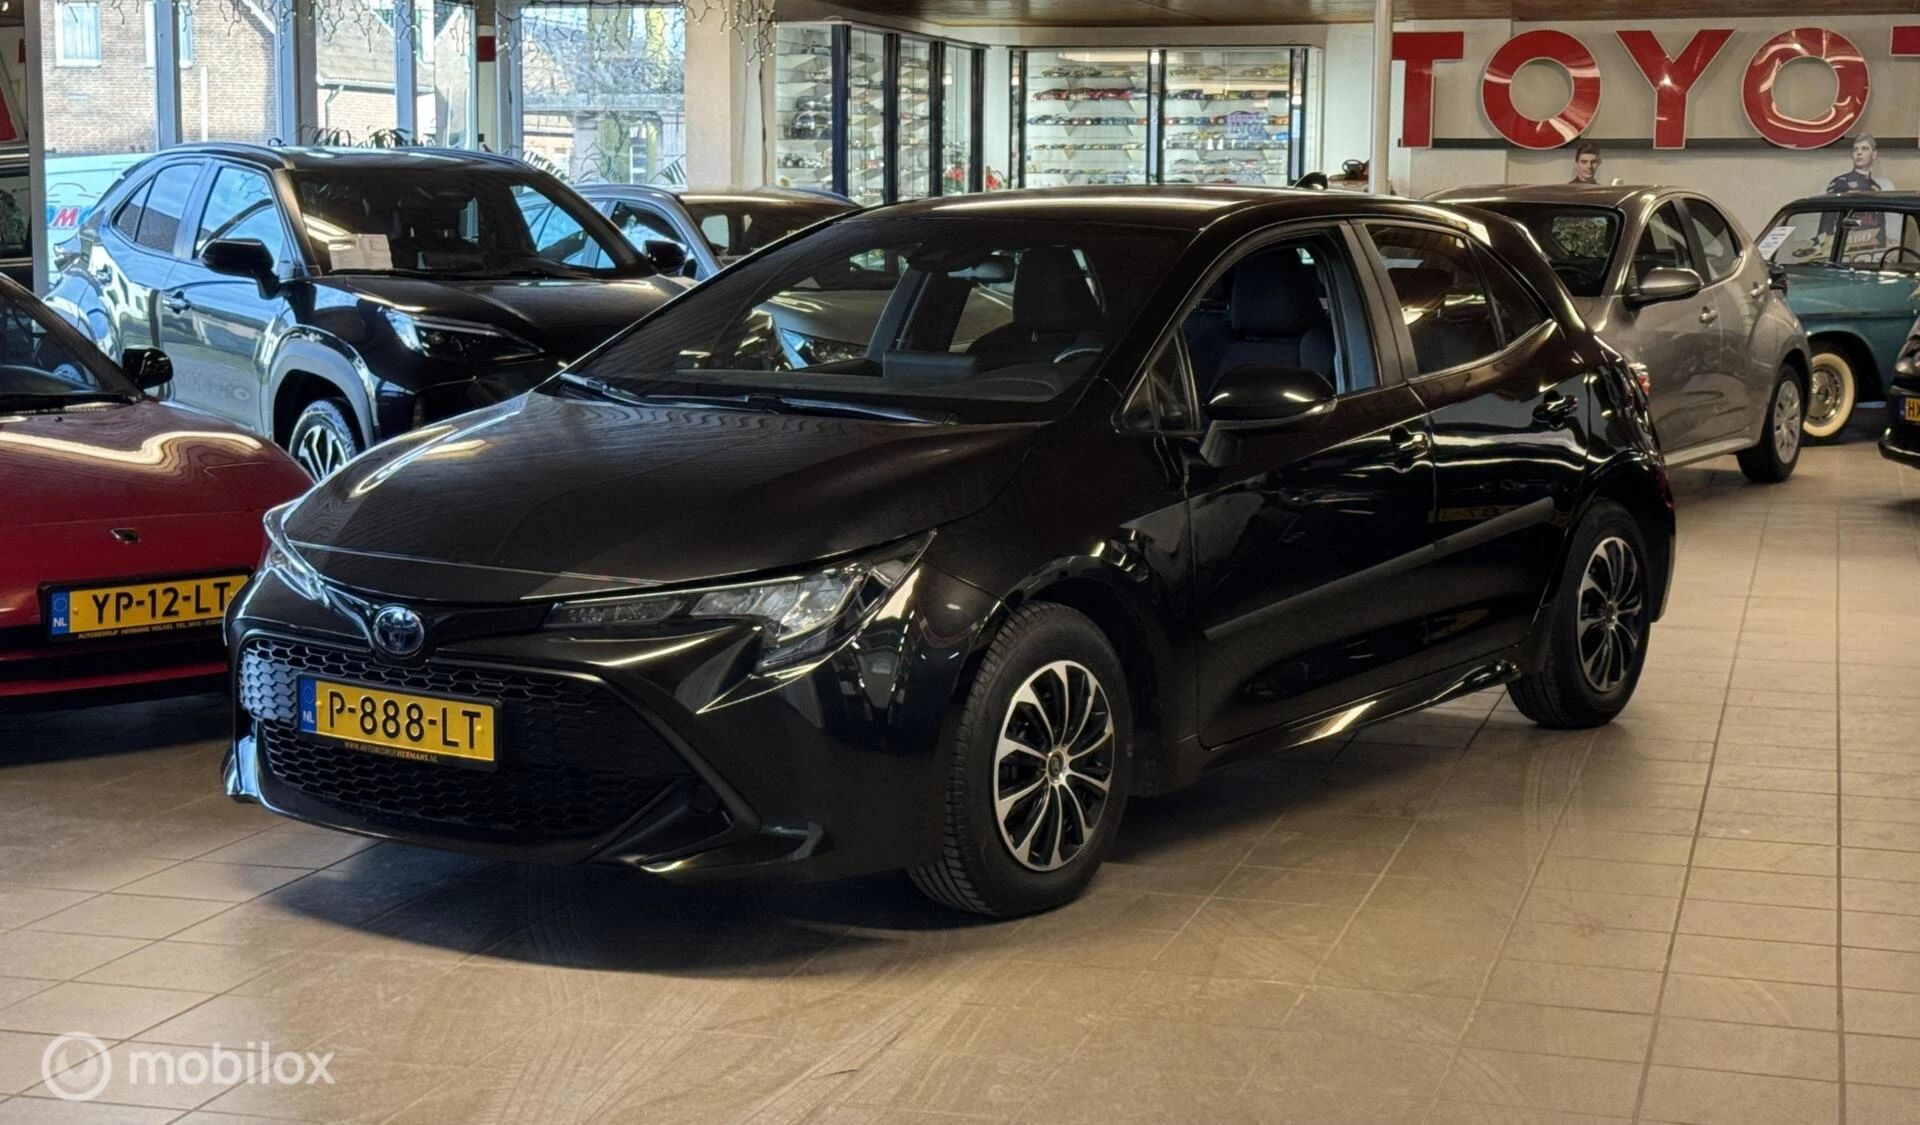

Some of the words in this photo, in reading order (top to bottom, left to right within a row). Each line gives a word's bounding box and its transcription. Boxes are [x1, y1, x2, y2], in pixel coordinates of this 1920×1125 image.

[1393, 27, 1920, 150] TOYO
[53, 617, 67, 628] NL
[91, 581, 231, 625] YP-12-LT
[302, 709, 315, 724] NL
[328, 690, 482, 750] P-888-LT
